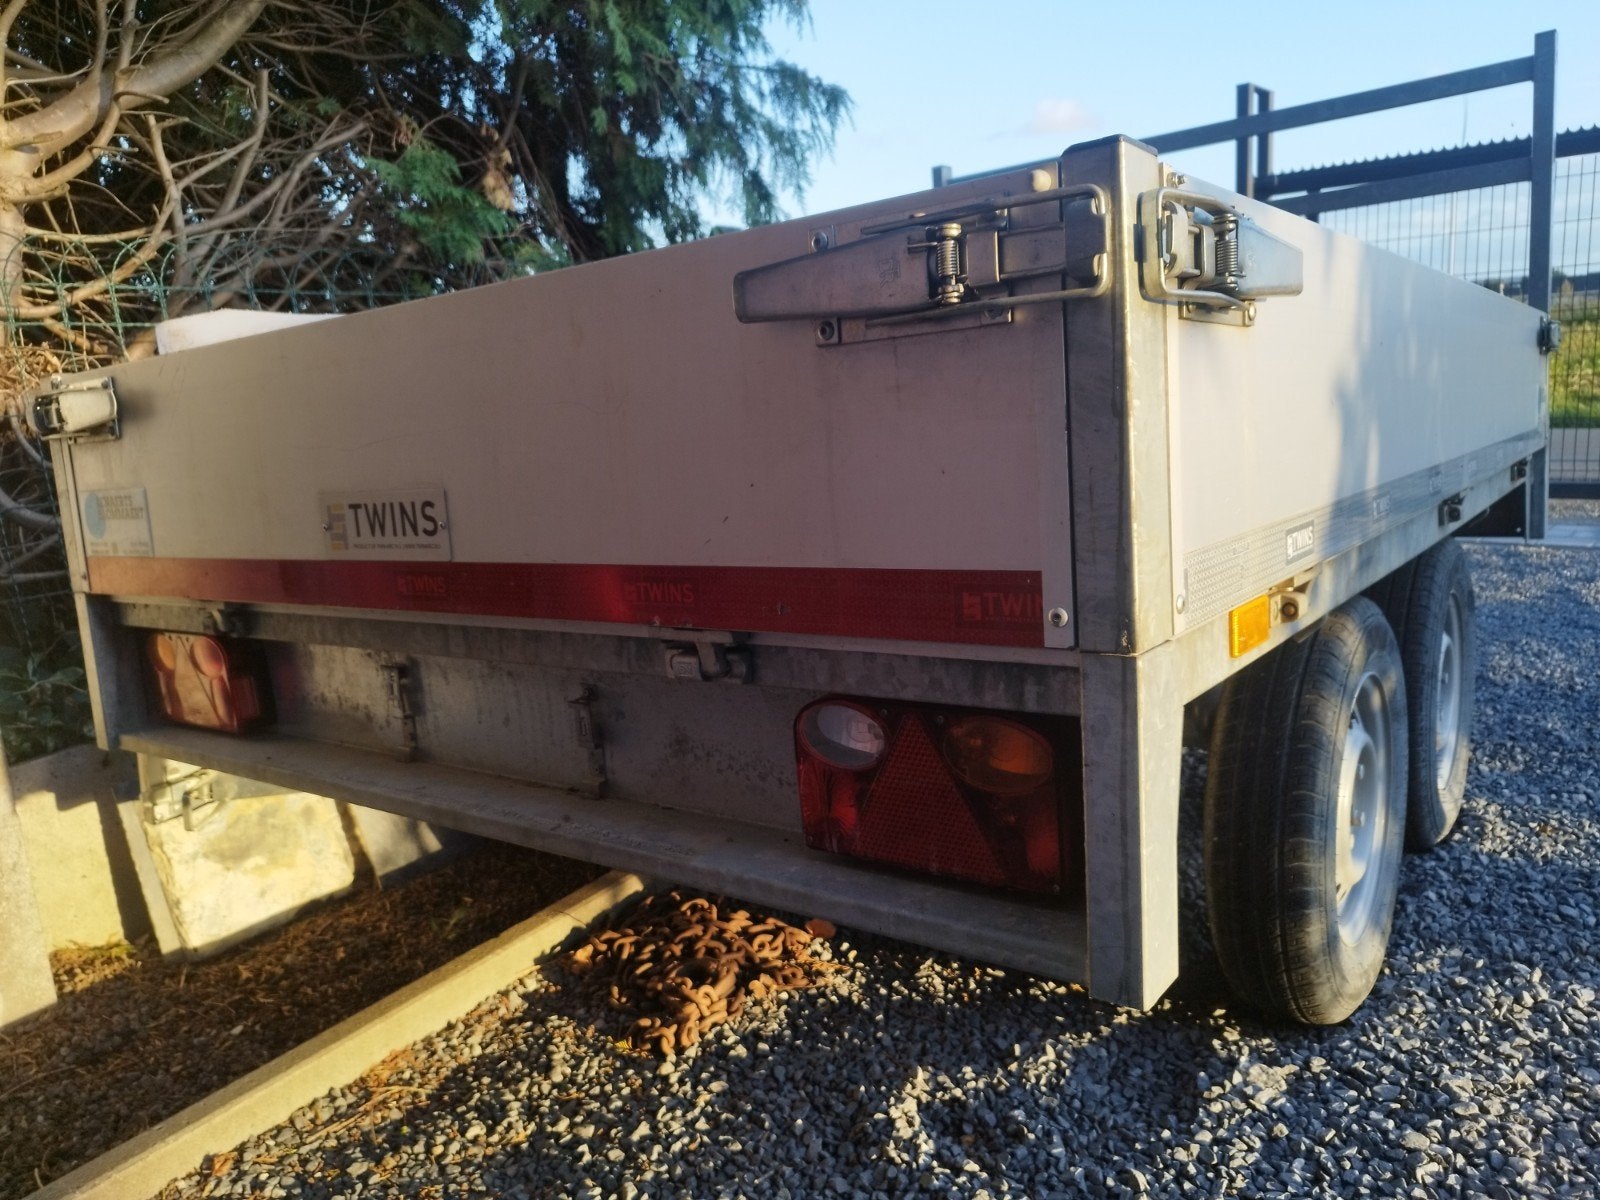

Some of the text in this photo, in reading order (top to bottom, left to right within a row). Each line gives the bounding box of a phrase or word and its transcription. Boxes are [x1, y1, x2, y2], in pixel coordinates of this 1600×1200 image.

[348, 500, 438, 537] TWINS
[1291, 526, 1313, 552] TWINS
[636, 582, 695, 603] TWINS
